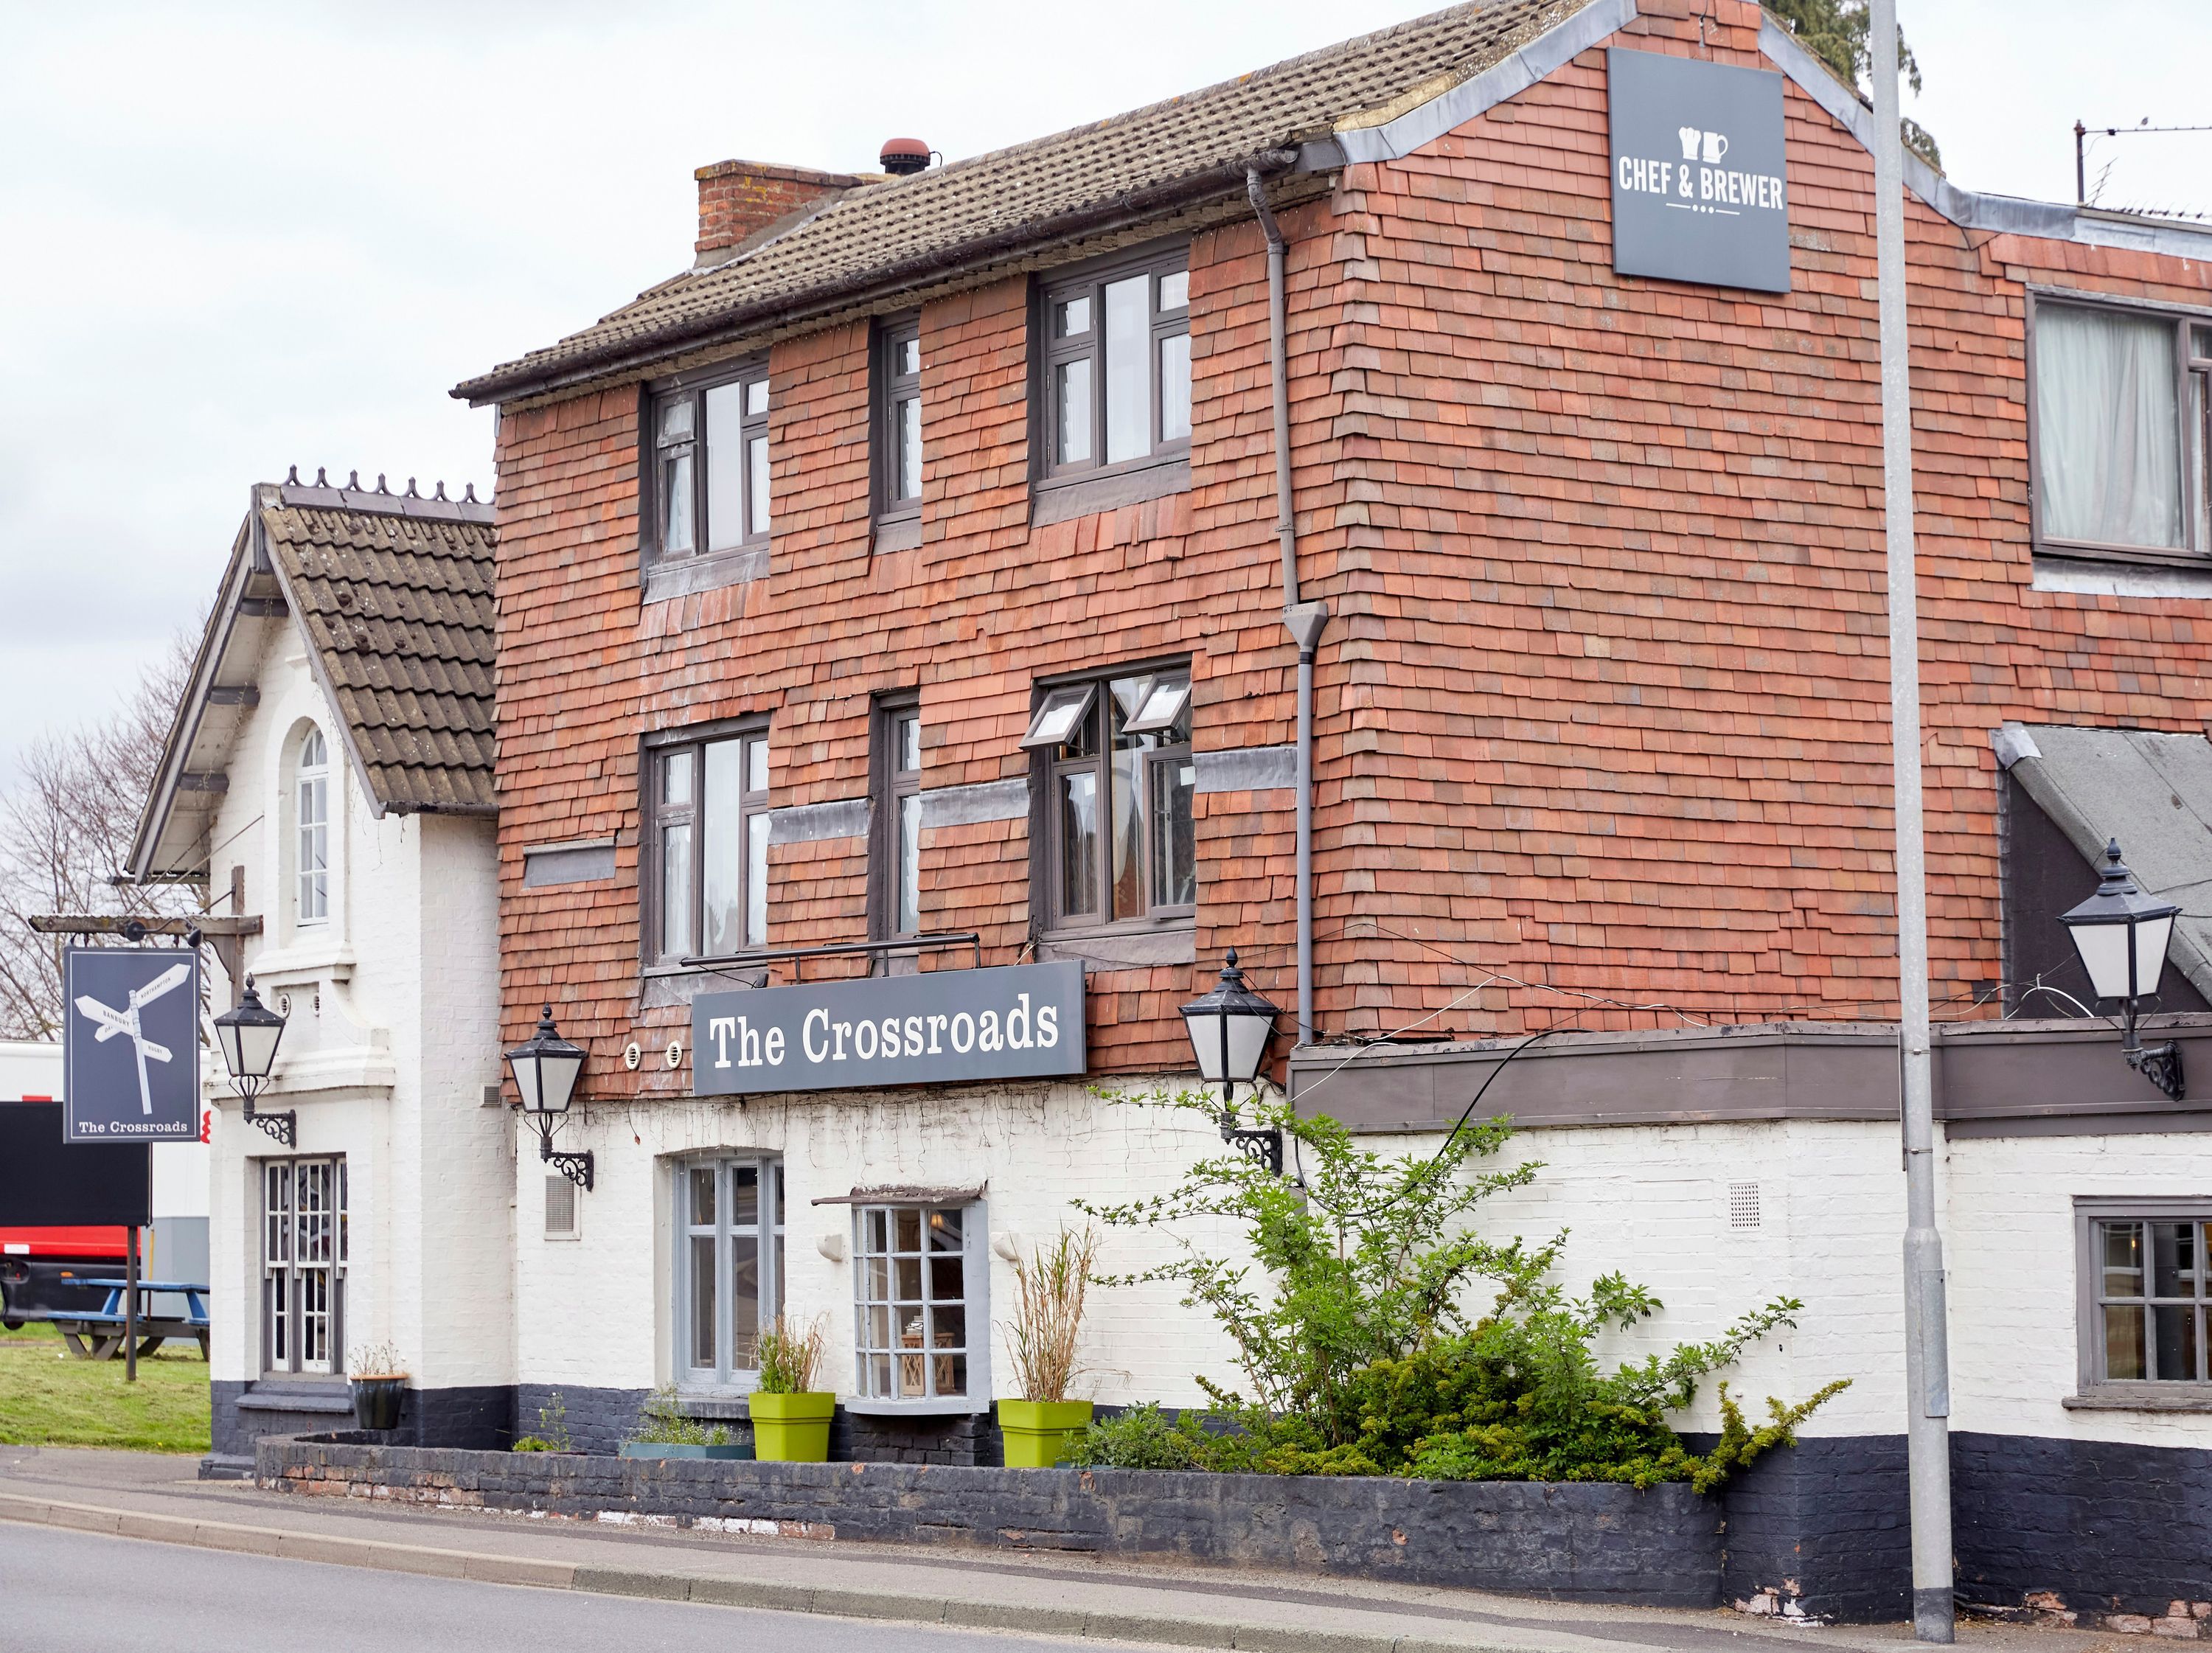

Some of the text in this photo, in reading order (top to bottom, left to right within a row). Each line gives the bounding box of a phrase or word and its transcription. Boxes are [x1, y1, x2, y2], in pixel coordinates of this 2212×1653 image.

[1619, 156, 1783, 210] CHEF & BREWER
[140, 977, 171, 998] NORTHAMPTON
[103, 1009, 129, 1026] BANBURY
[709, 993, 1059, 1068] The Crossroads
[147, 1045, 162, 1054] RUGBY
[79, 1121, 188, 1133] The Crossroads
